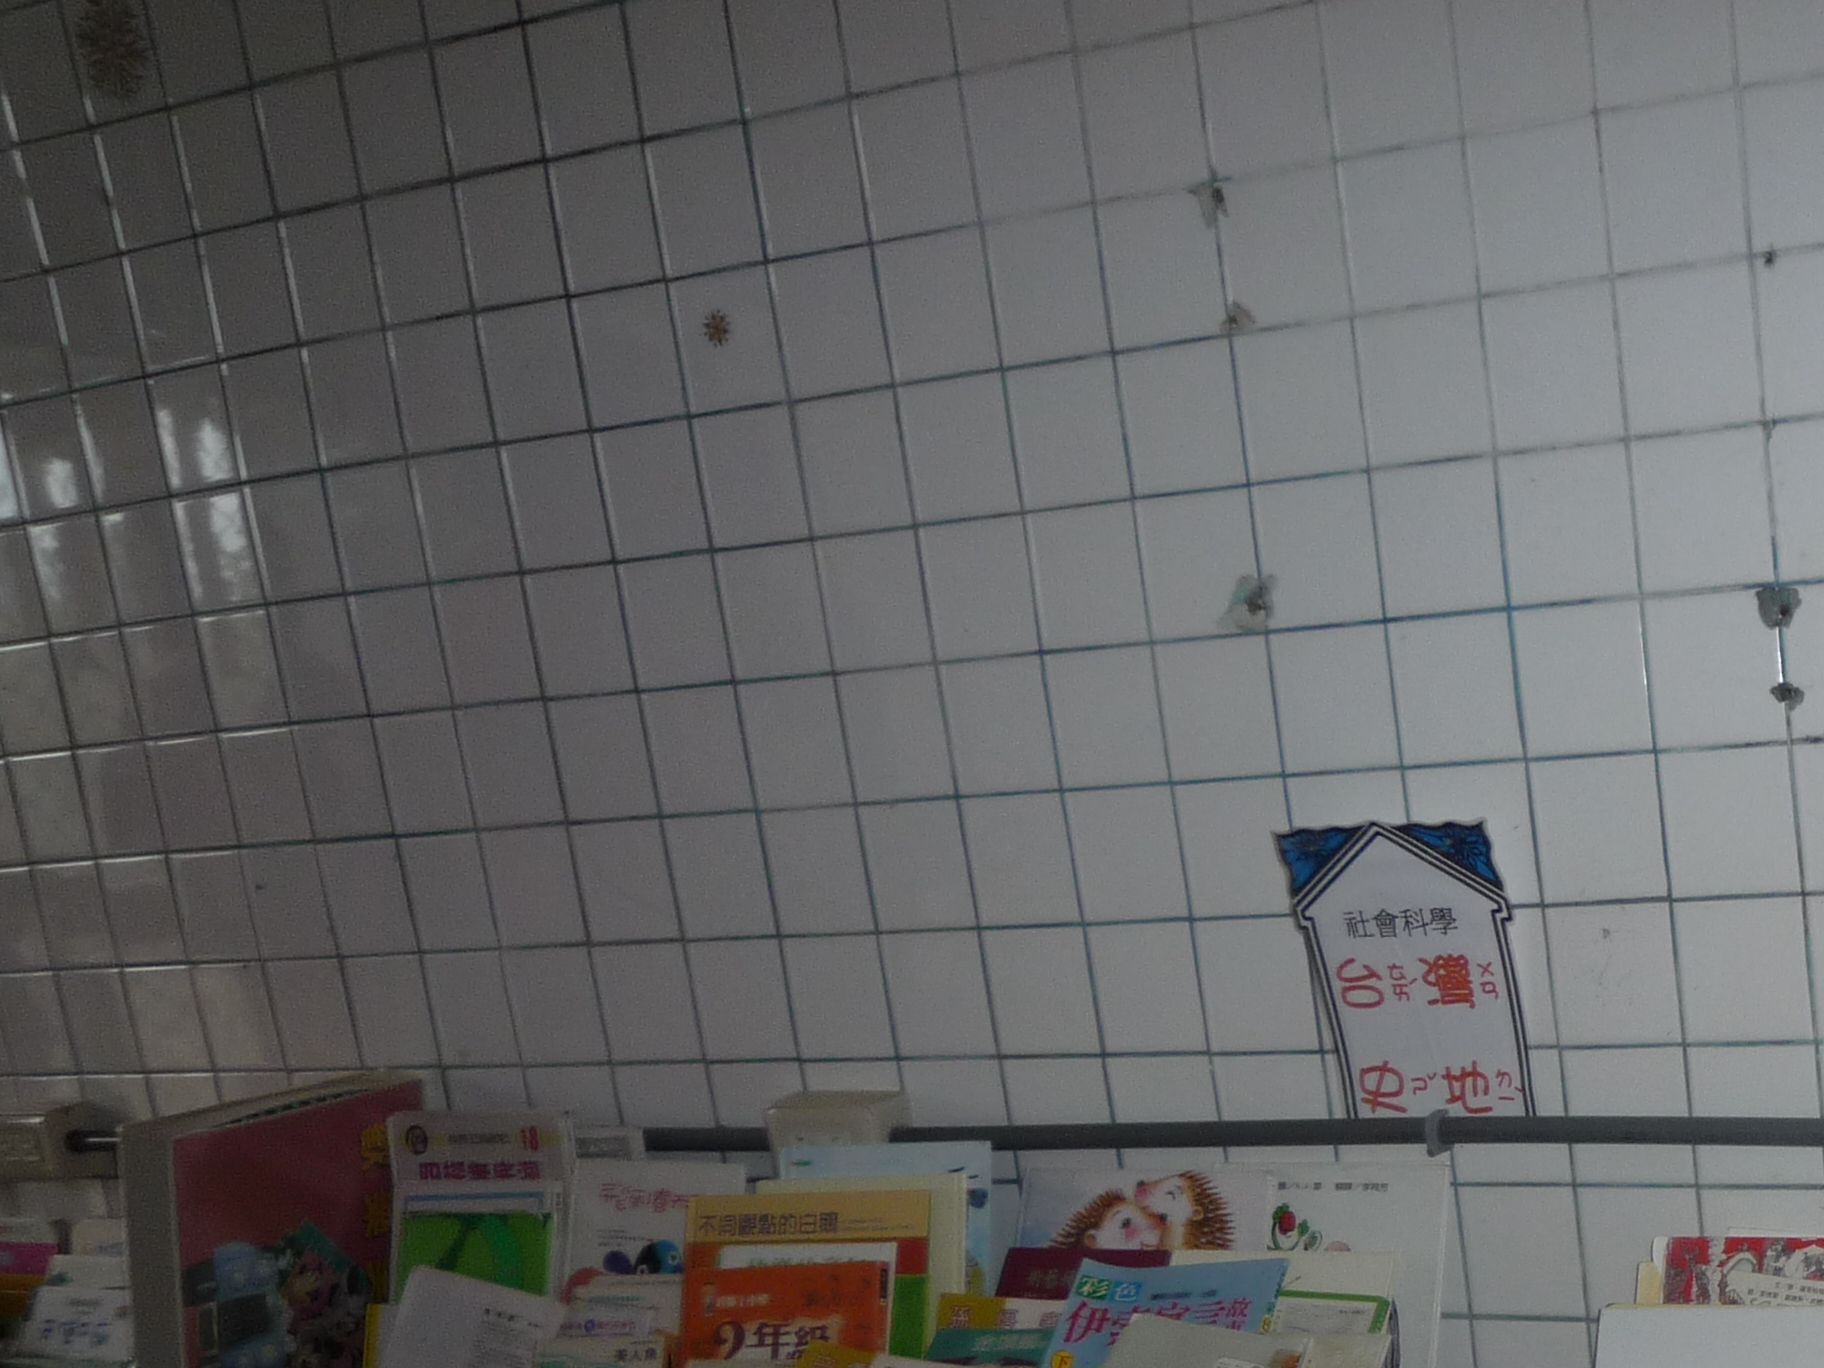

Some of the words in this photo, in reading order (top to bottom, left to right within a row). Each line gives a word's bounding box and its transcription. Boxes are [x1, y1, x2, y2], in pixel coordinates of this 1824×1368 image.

[1344, 907, 1458, 938] 社會科學
[520, 1127, 540, 1151] 18
[1079, 1276, 1138, 1299] 彩色
